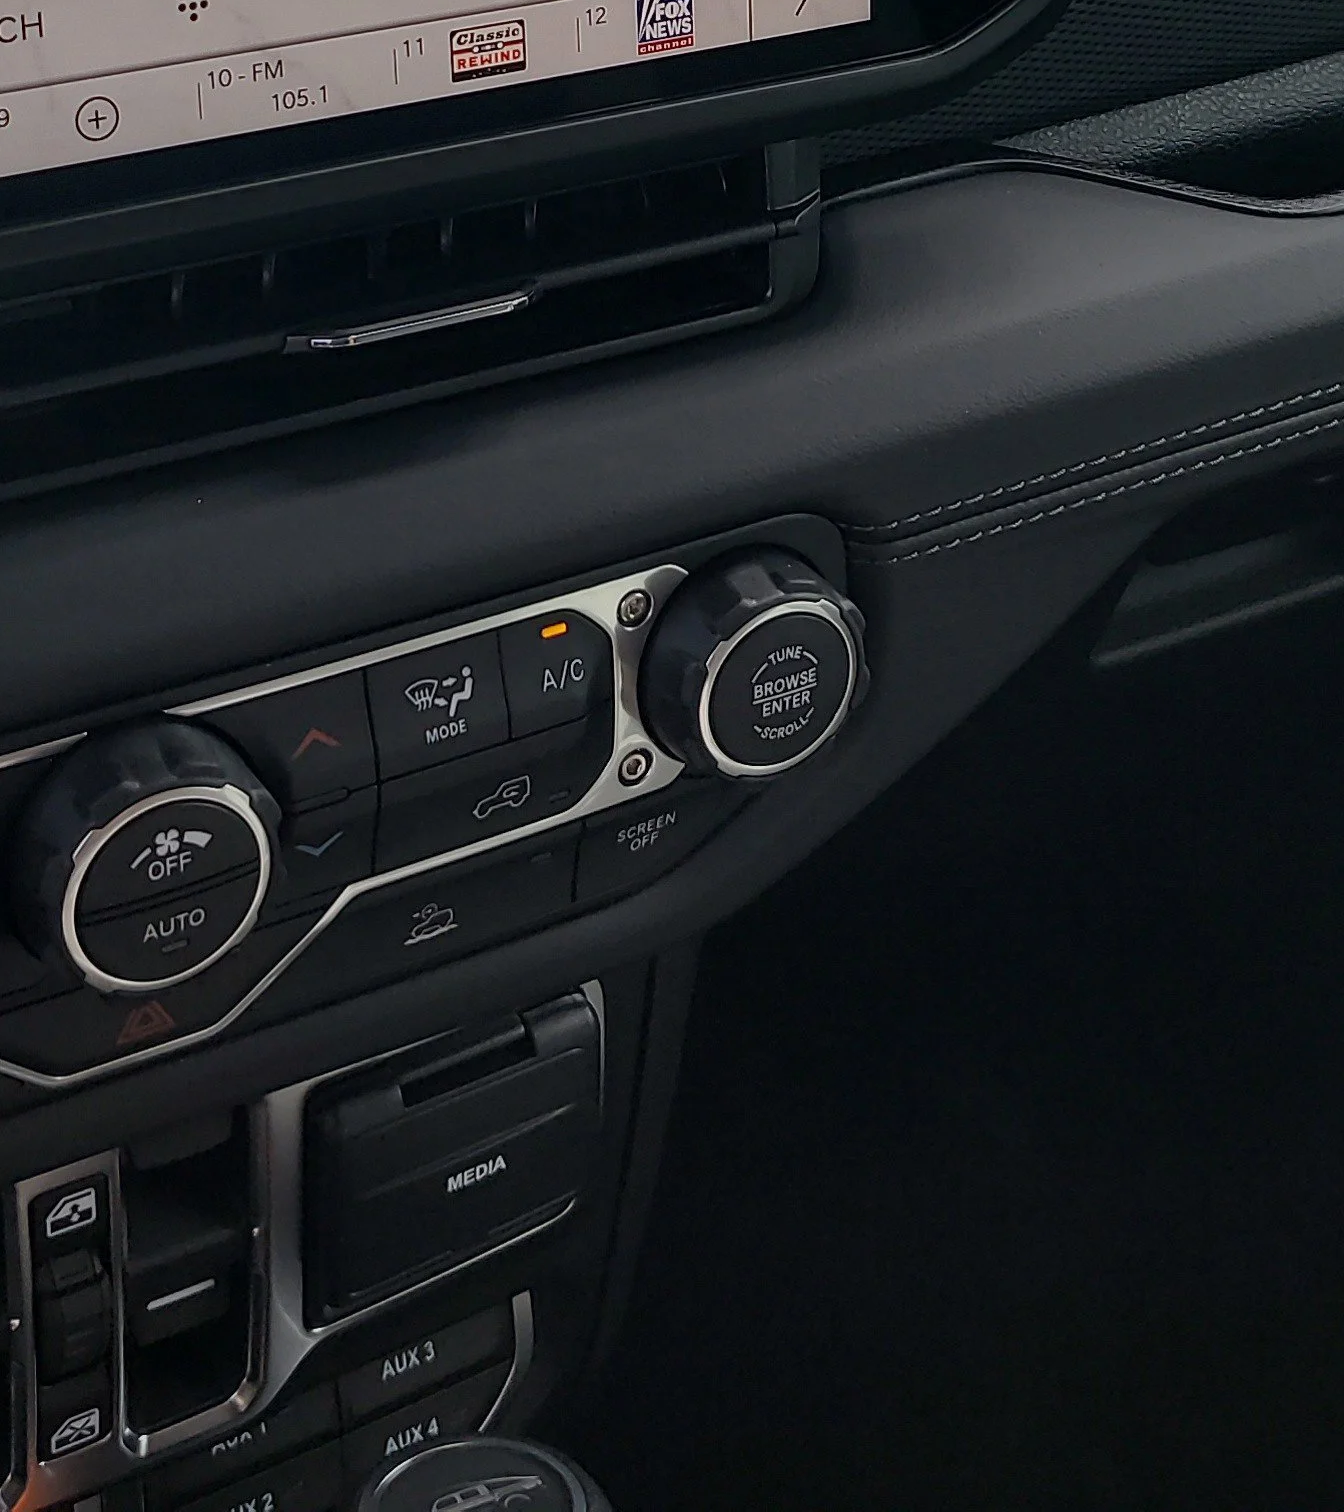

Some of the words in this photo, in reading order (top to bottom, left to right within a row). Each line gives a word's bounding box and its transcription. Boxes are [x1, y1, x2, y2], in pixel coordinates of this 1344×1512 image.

[585, 7, 607, 26] 12
[645, 17, 692, 40] NEWS
[403, 38, 424, 58] 11
[456, 27, 519, 45] Classic
[640, 37, 692, 53] channel
[457, 49, 520, 70] REWIND
[207, 67, 233, 90] 10
[252, 60, 284, 83] FM
[271, 85, 329, 113] 105.1
[767, 645, 803, 666] TUNE
[542, 657, 586, 693] A/C
[753, 667, 817, 700] BROWSE
[762, 690, 811, 718] ENTER
[425, 718, 468, 745] MODE
[761, 715, 809, 740] SCROLL
[617, 810, 676, 845] SCREEN
[629, 830, 659, 853] OFF
[148, 849, 193, 881] OFF
[143, 907, 206, 943] AUTO
[446, 1154, 507, 1193] MEDIA
[382, 1346, 420, 1381] AUX
[423, 1340, 435, 1361] 3
[384, 1423, 424, 1456] AUX
[427, 1416, 439, 1436] 4
